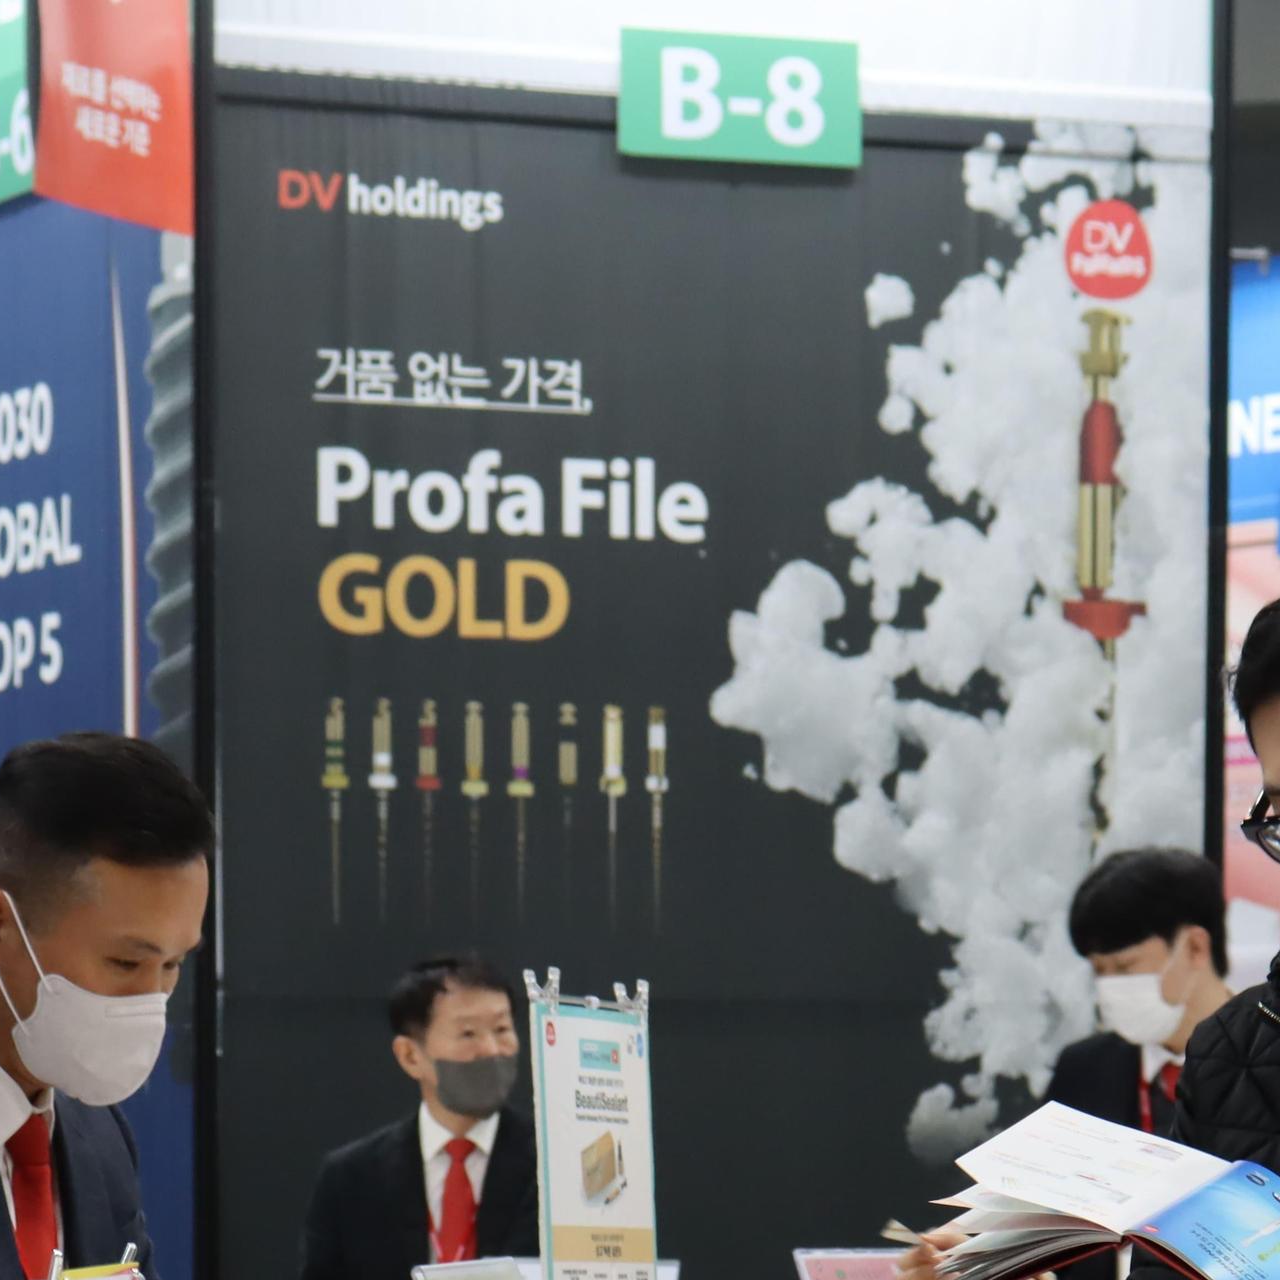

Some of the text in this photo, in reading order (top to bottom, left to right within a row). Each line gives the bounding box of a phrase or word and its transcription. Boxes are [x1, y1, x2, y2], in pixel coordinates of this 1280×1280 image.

[660, 47, 825, 146] B-8
[278, 171, 504, 231] DV holdings
[1082, 219, 1134, 253] DV
[315, 347, 399, 401] 거품
[408, 351, 491, 405] 없는
[316, 447, 708, 544] Profa File
[318, 553, 570, 641] GOLD
[37, 612, 64, 686] 5
